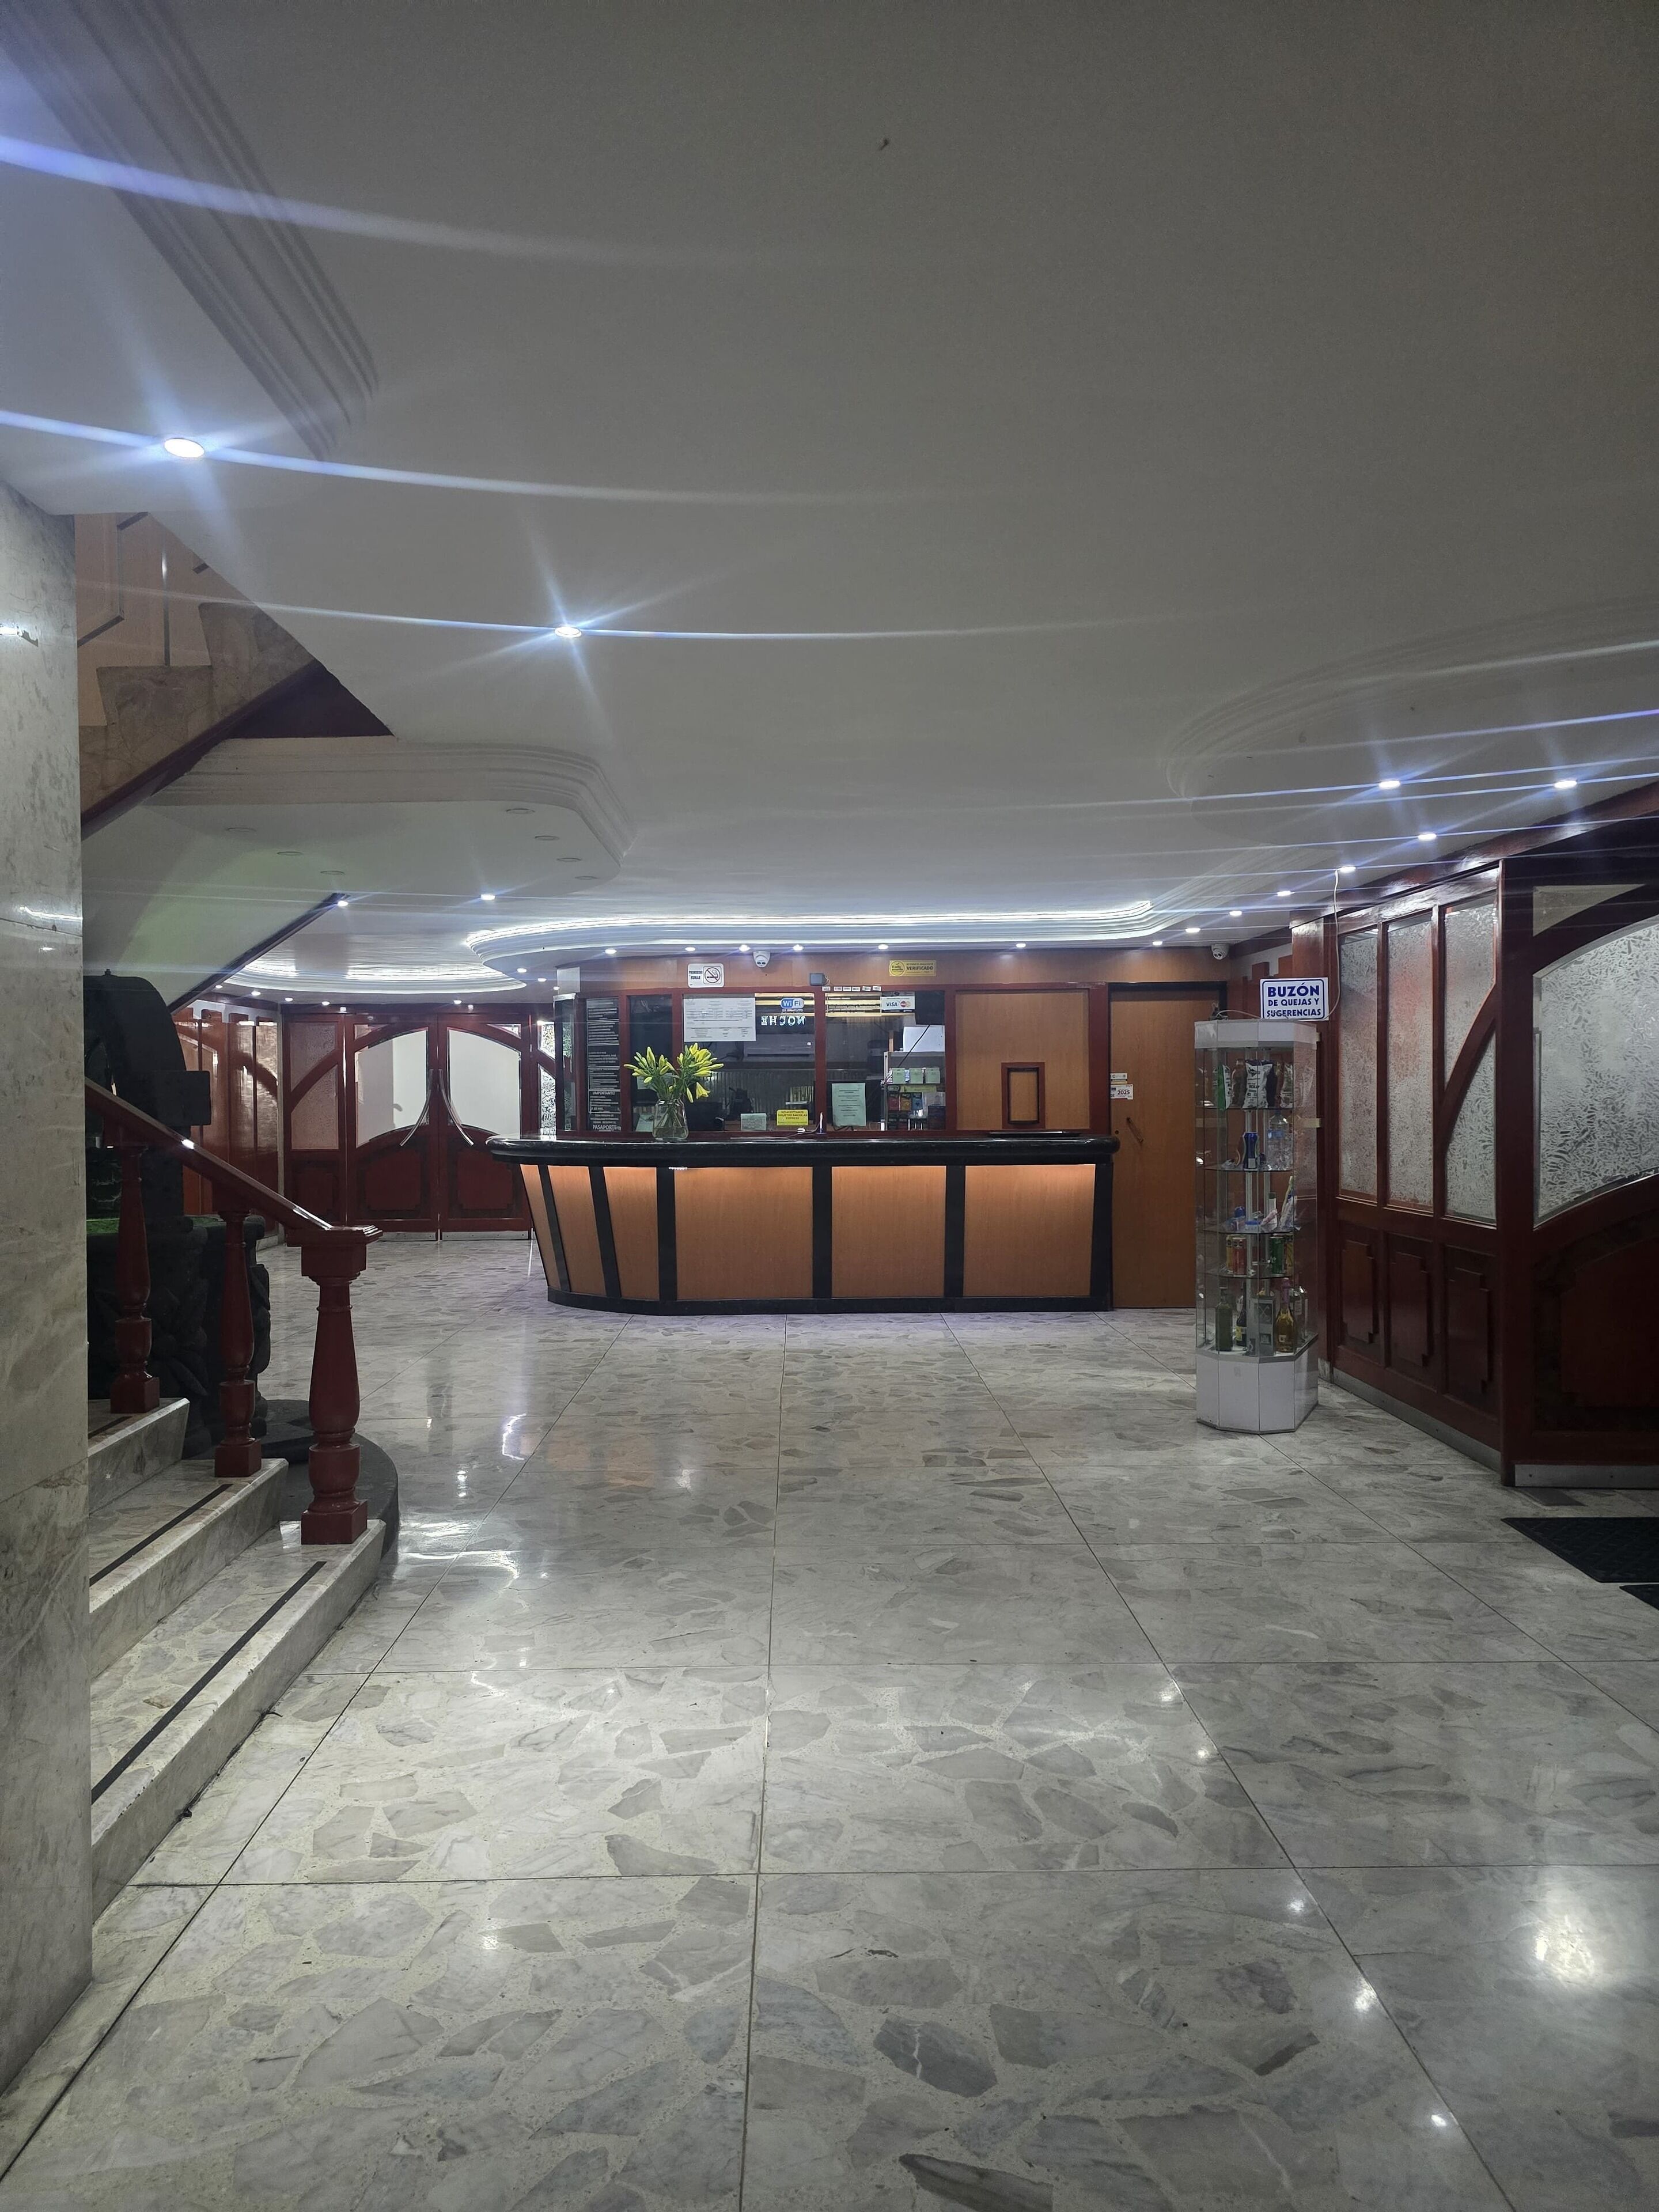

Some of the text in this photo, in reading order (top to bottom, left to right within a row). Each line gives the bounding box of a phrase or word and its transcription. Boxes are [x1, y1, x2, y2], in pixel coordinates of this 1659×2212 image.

[1267, 982, 1320, 997] BUZÓN
[1281, 998, 1312, 1006] QUEJAS
[1267, 1009, 1321, 1017] SUGERENCIAS
